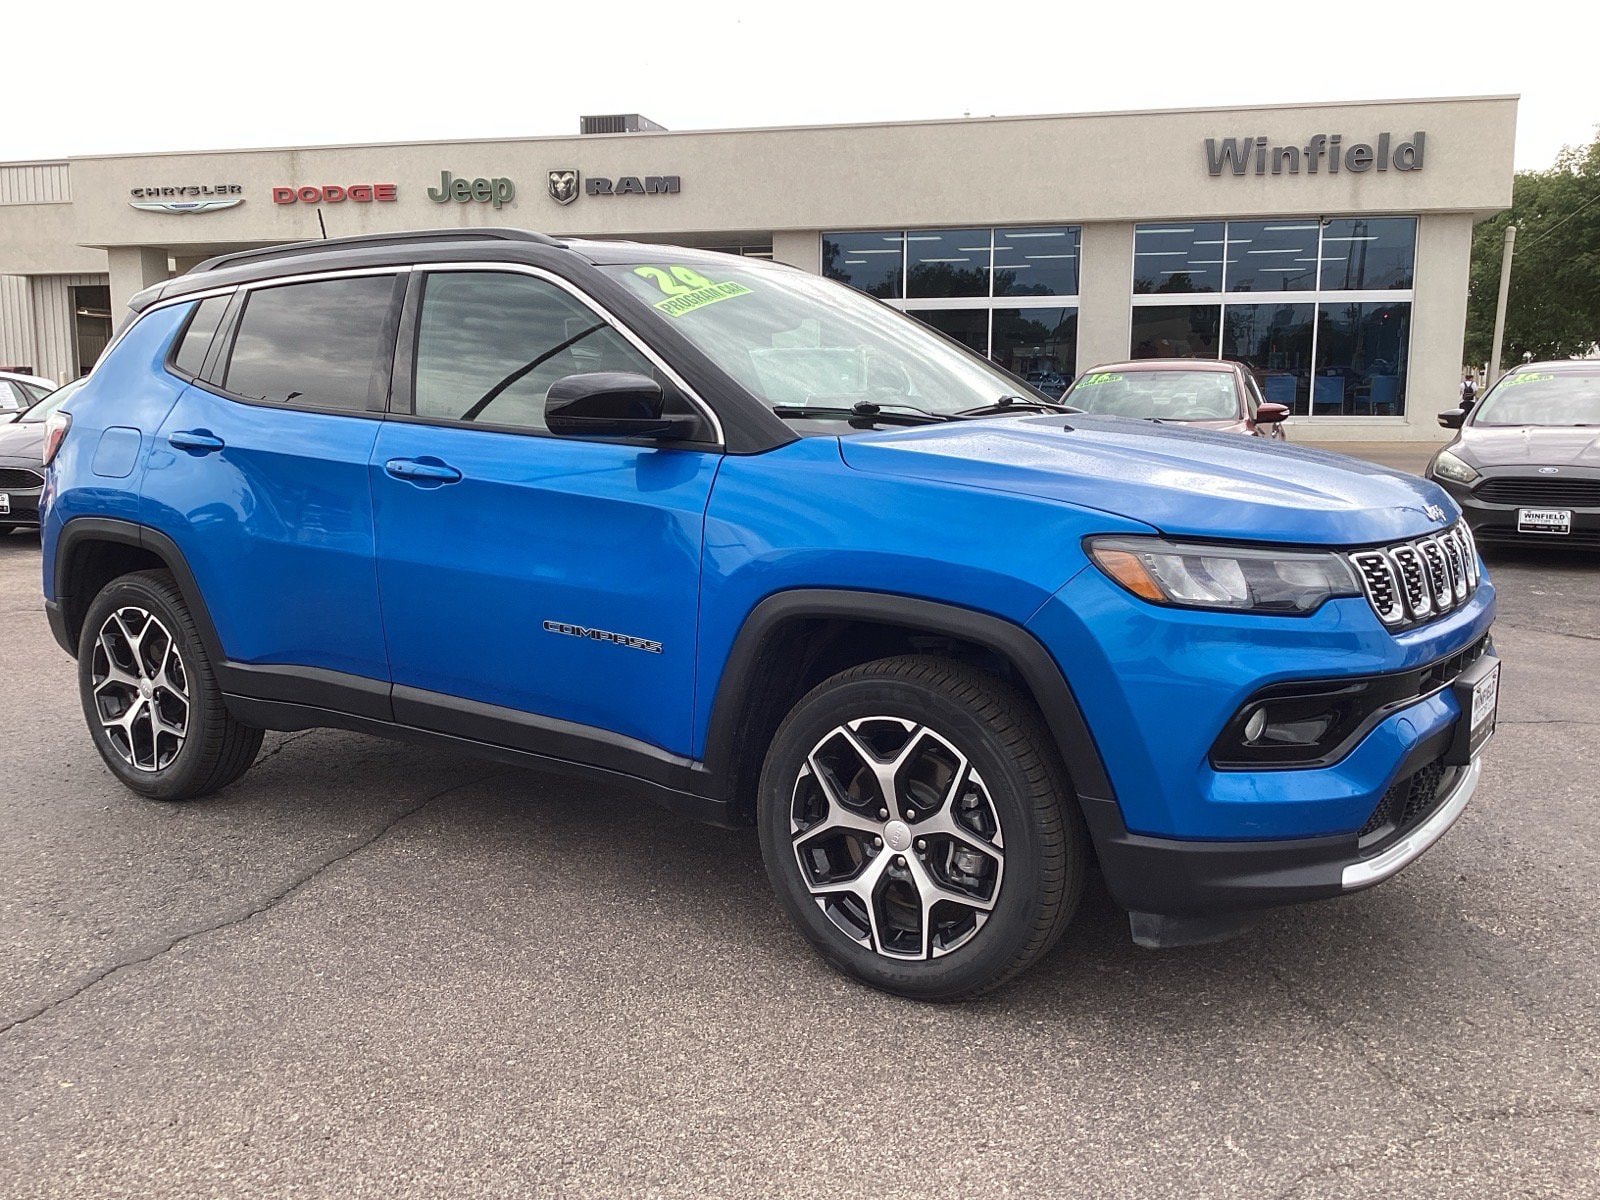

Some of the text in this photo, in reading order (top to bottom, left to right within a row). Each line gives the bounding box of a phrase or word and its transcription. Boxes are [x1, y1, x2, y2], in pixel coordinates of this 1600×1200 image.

[1204, 131, 1426, 176] Winfield
[130, 184, 242, 198] CHRYSLER
[272, 183, 398, 204] DODGE
[427, 170, 516, 208] Jeep
[585, 176, 681, 196] RAM
[661, 281, 747, 314] PROGRAM CAR
[1524, 512, 1565, 520] WINFIELD
[543, 620, 663, 654] COMPASS
